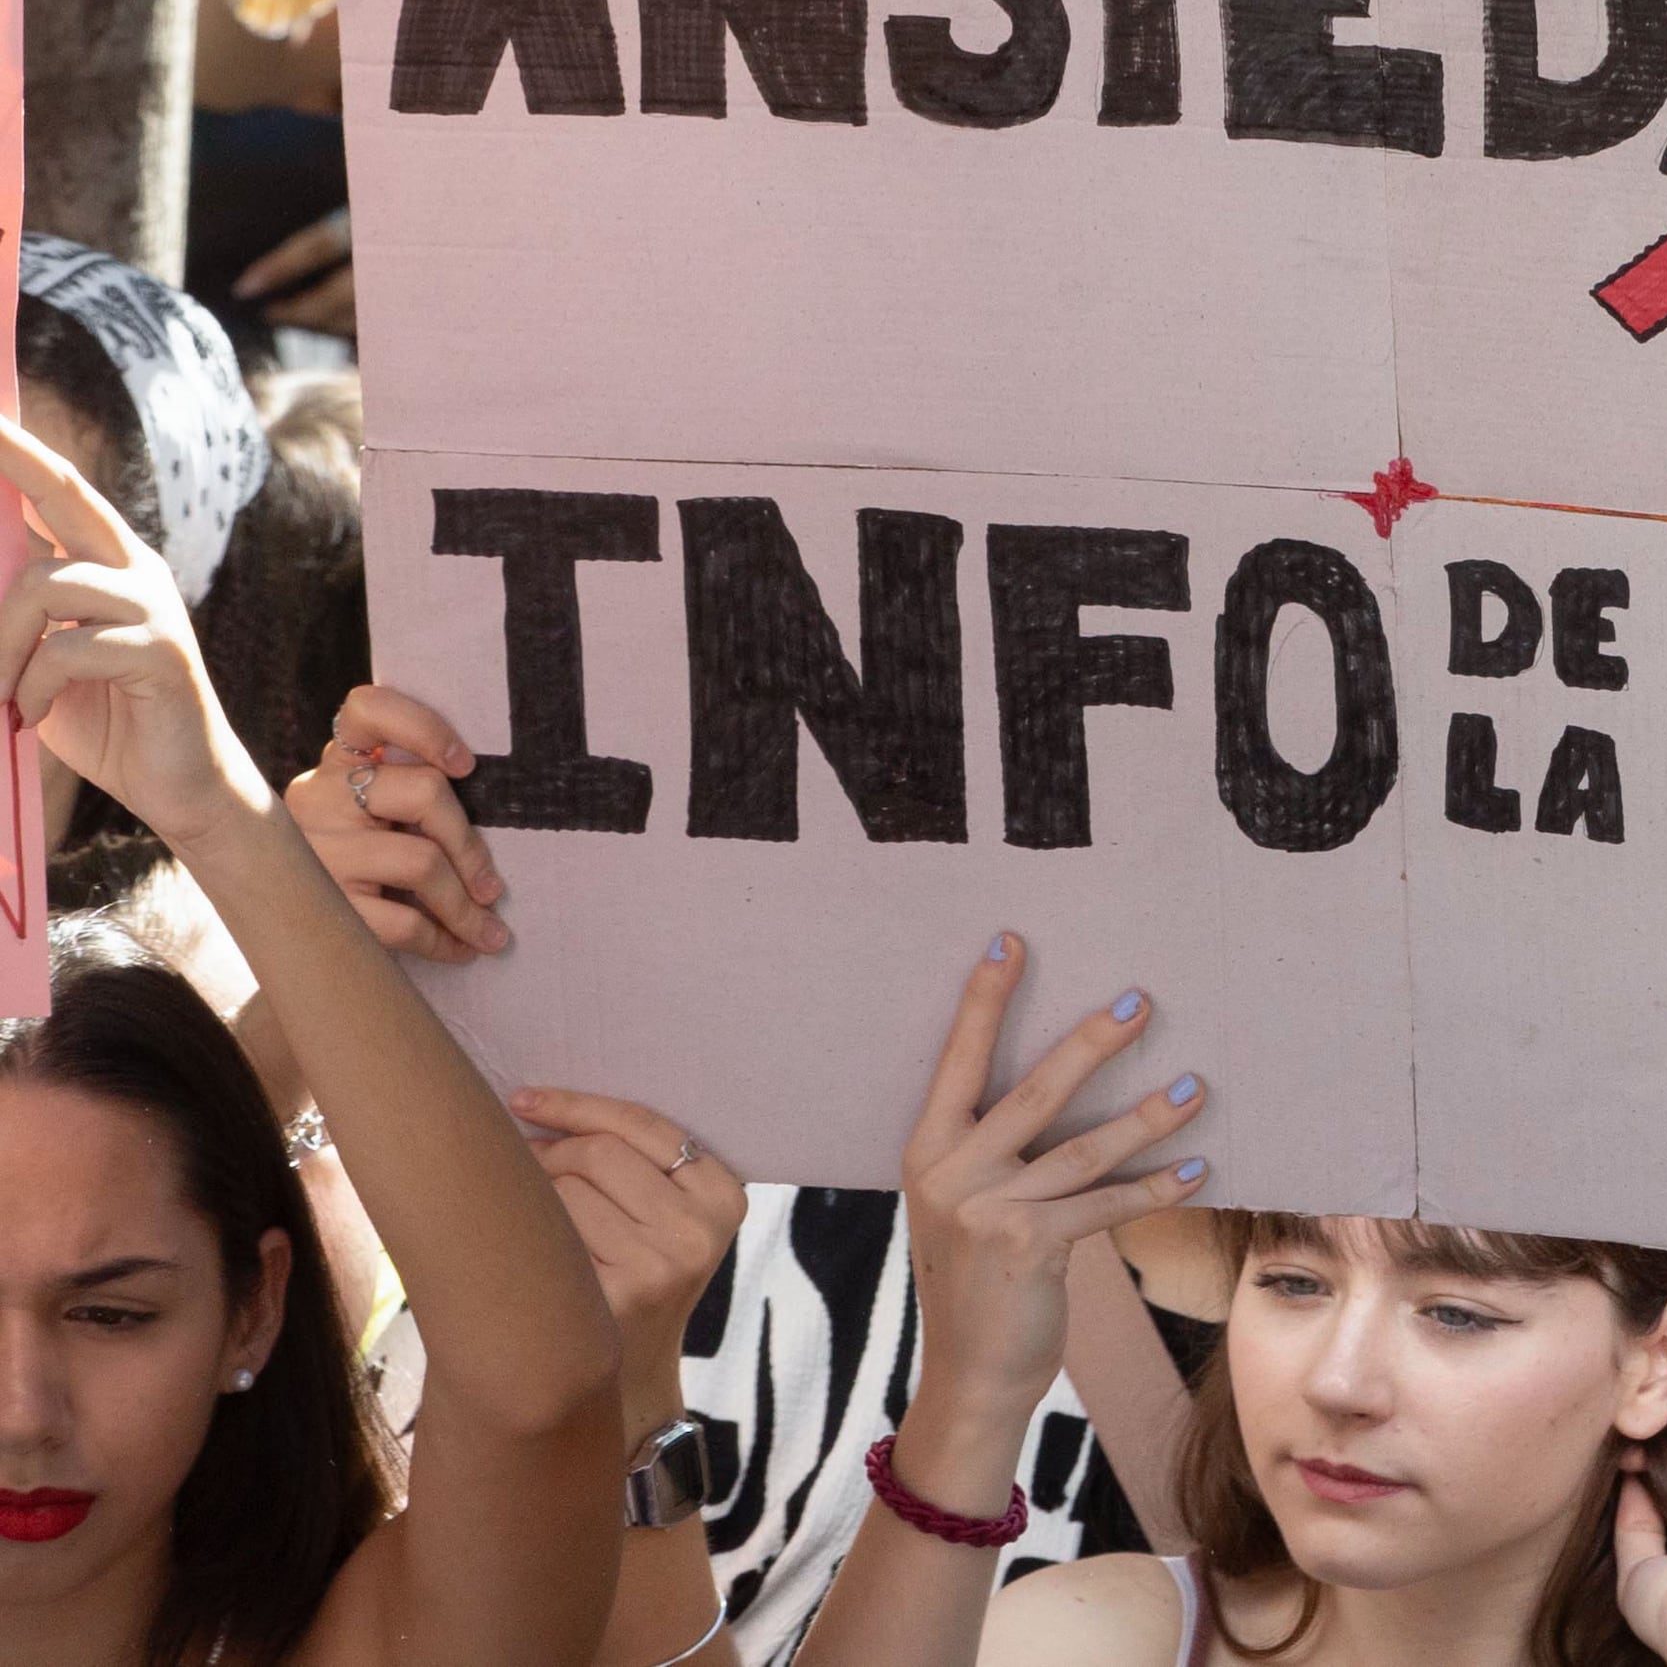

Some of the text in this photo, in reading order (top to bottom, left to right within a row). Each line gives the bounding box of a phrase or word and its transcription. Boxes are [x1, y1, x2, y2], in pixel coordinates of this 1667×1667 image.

[432, 488, 1401, 854] INFO
[1444, 558, 1630, 692] DE
[1444, 711, 1625, 845] LA
